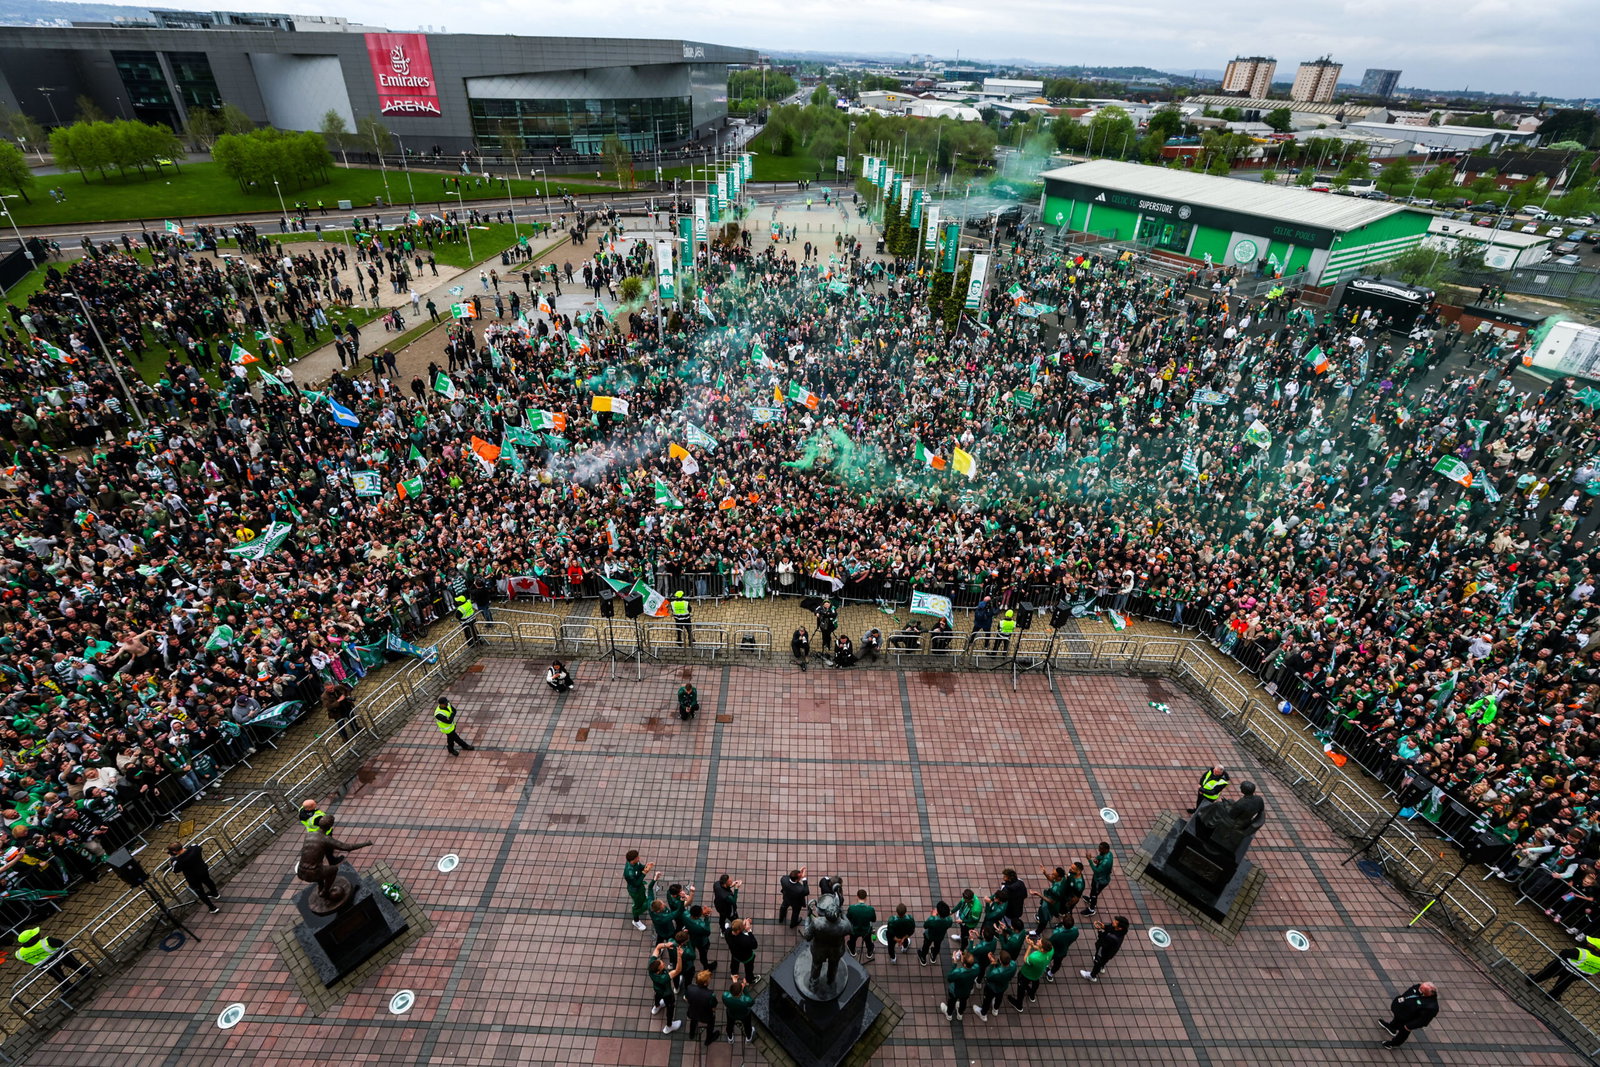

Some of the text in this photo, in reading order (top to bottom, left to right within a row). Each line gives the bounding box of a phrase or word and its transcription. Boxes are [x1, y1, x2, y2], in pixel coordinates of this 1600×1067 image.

[379, 73, 430, 87] Emirates
[382, 100, 440, 114] ARENA
[1112, 194, 1129, 205] CELTIC
[1139, 199, 1174, 214] SUPERSTORE
[1273, 226, 1317, 241] CELTIC POOLS
[684, 245, 689, 253] TO
[949, 239, 955, 247] TO
